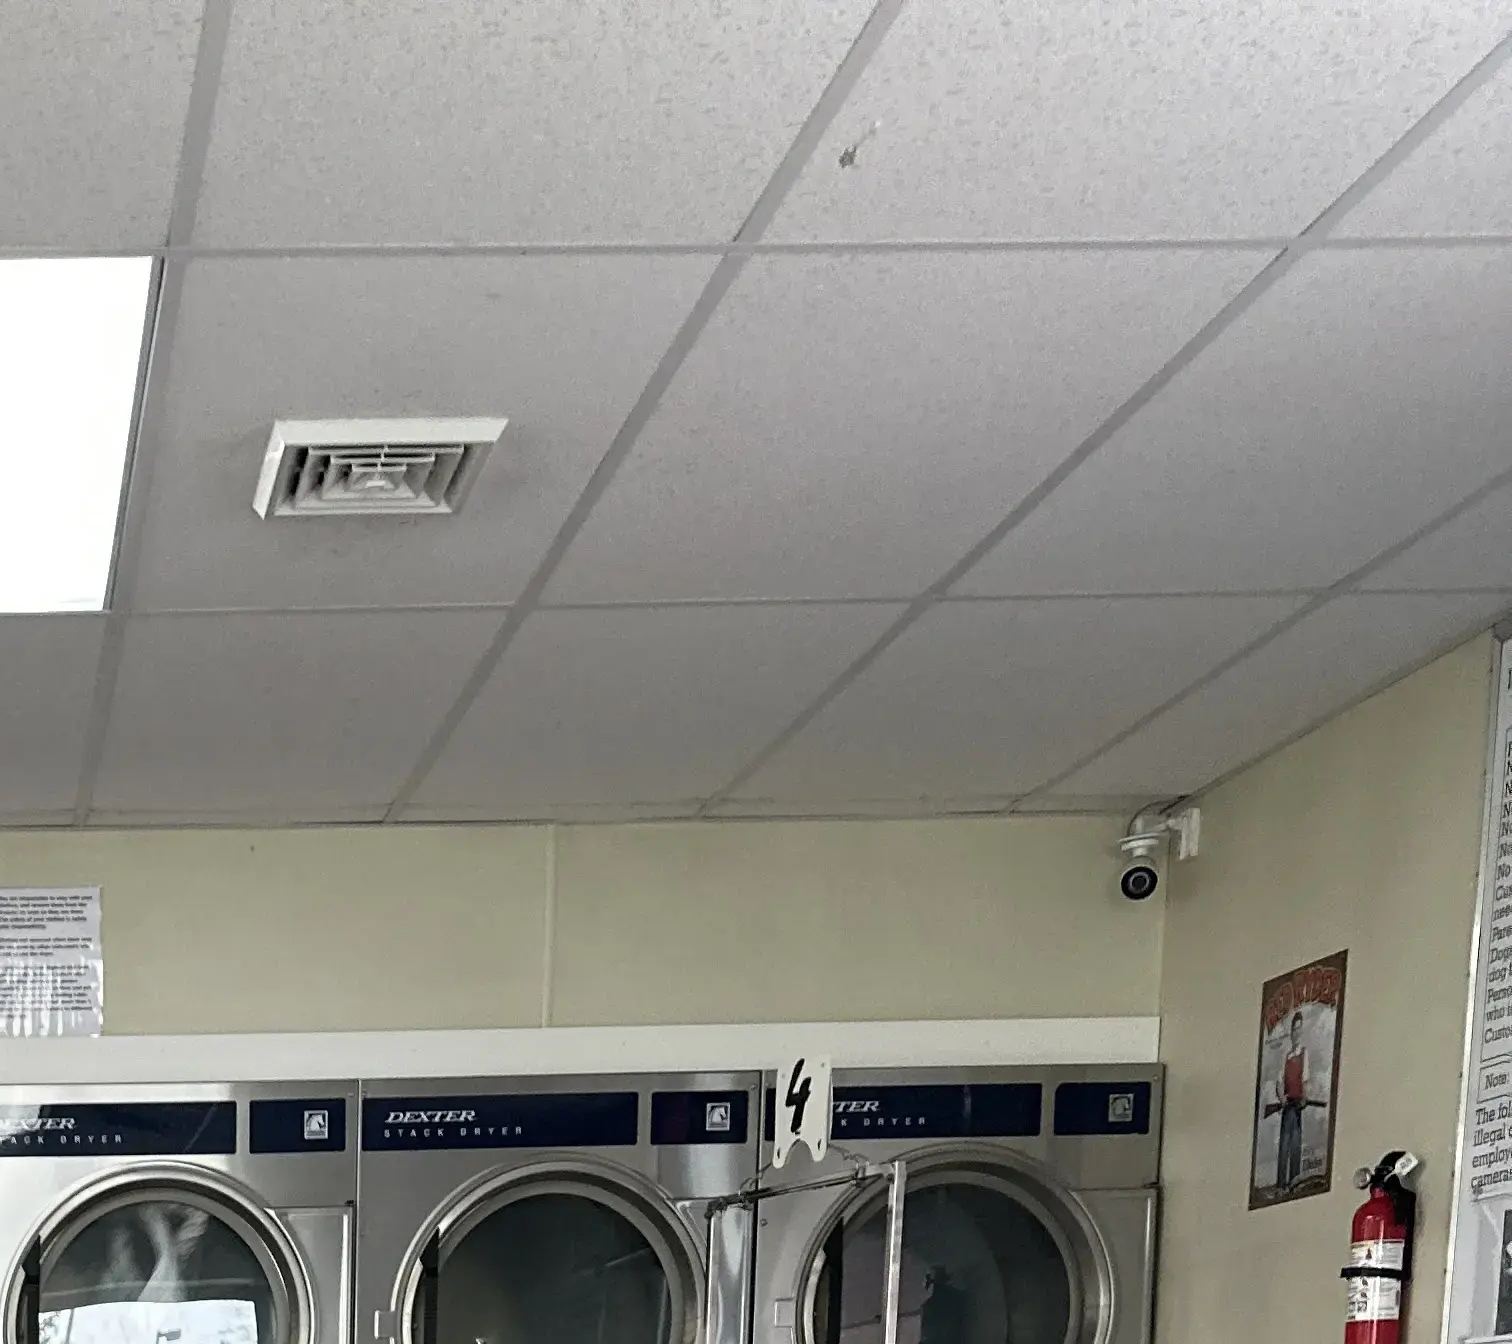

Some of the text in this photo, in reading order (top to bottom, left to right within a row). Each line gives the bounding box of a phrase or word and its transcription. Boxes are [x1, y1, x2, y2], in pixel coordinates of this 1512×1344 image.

[785, 1058, 812, 1133] 4
[833, 1101, 880, 1113] TER
[385, 1110, 477, 1124] DEXTER
[863, 1117, 926, 1127] DRYER
[1475, 1107, 1496, 1126] The
[384, 1126, 522, 1138] STACK DRYER
[1472, 1122, 1506, 1148] illegal
[60, 1135, 122, 1145] DRYER
